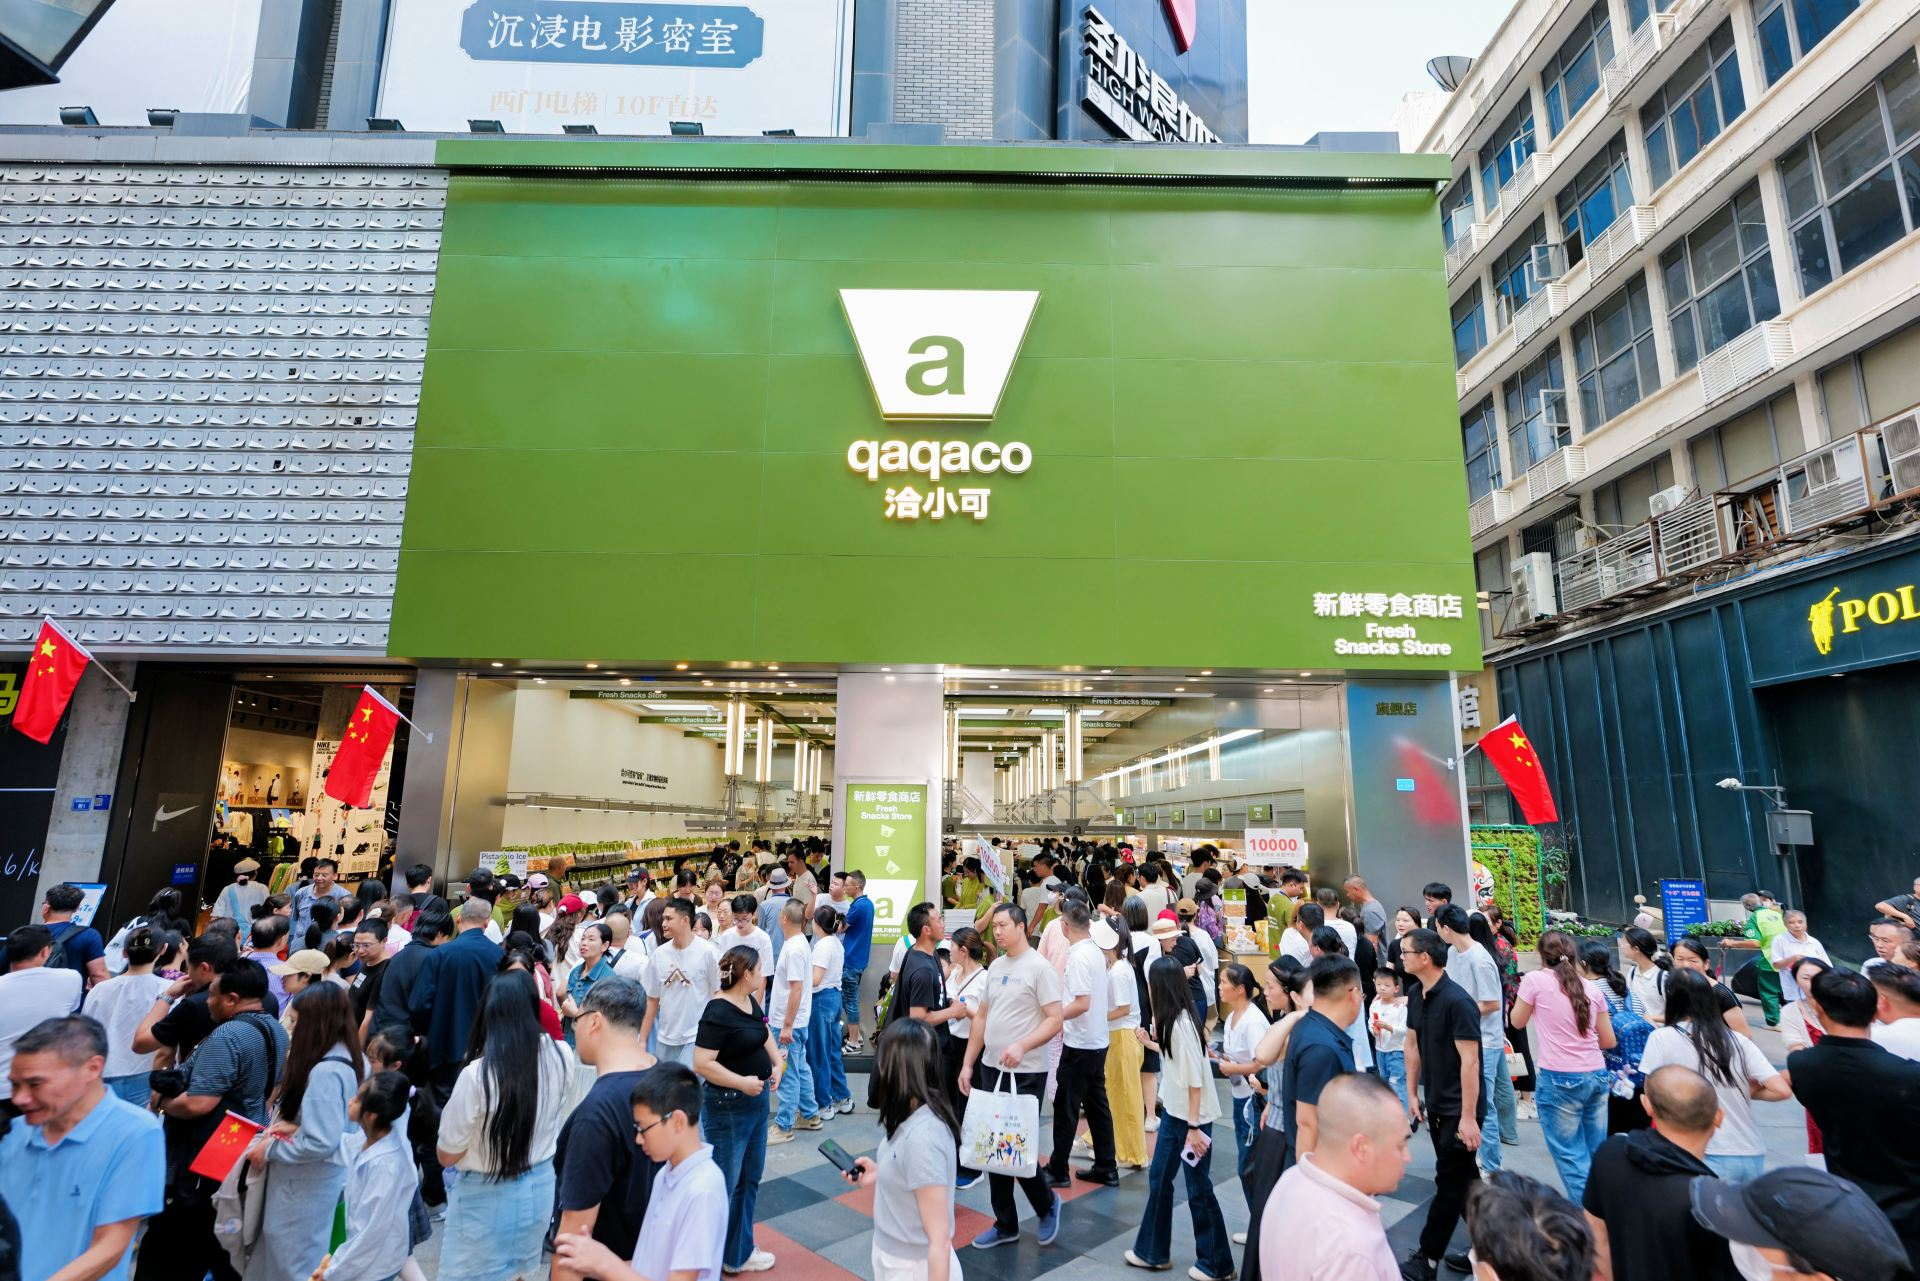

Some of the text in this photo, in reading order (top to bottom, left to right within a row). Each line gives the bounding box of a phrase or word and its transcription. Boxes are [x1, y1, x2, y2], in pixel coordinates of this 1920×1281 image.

[487, 10, 738, 55] 沉浸电影密室
[1084, 4, 1223, 143] 劲浪体
[490, 90, 719, 119] 西门电梯 10F直达
[905, 335, 966, 396] a
[847, 439, 1033, 481] qaqaco
[884, 486, 991, 519] 洽小可
[1837, 585, 1920, 633] POL
[1365, 623, 1416, 639] Fresh
[1334, 639, 1452, 656] Snacks Store
[620, 691, 646, 699] Snacks
[1141, 698, 1160, 706] Store
[860, 812, 913, 820] Snacks Store
[1249, 838, 1298, 851] 10000
